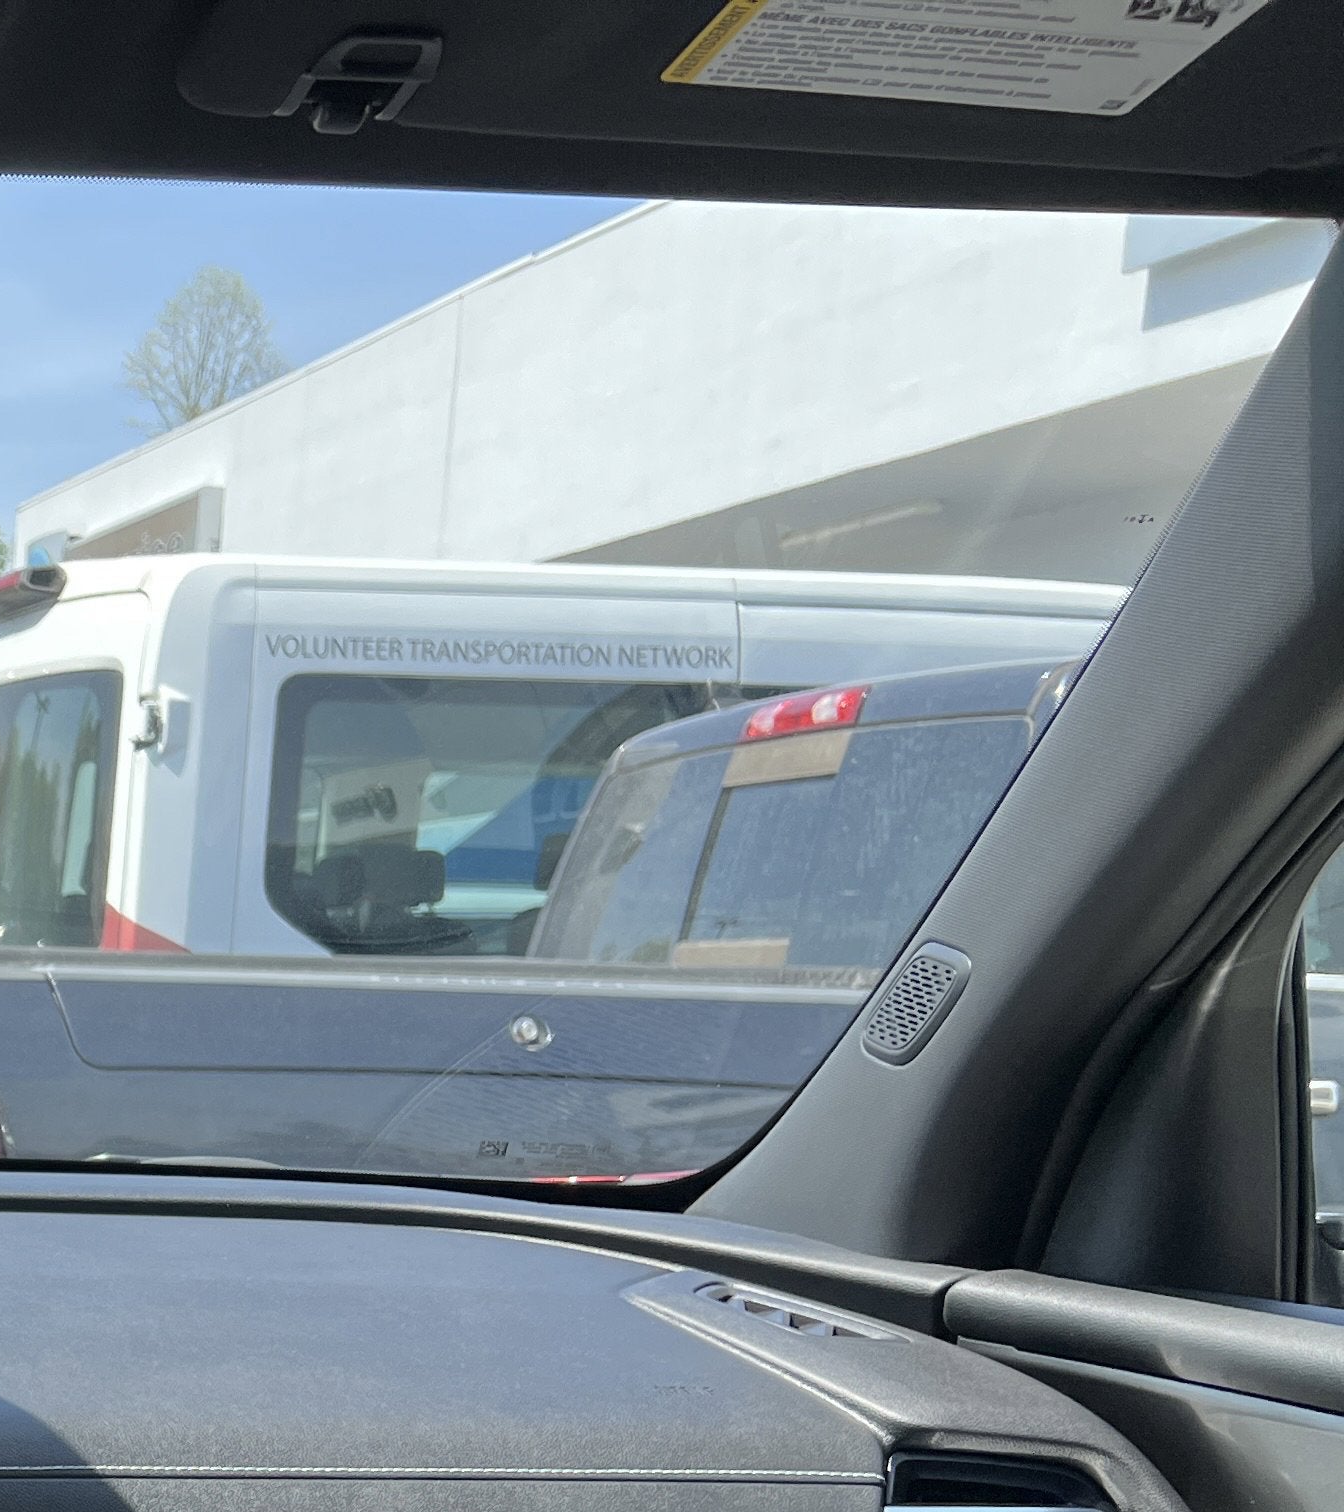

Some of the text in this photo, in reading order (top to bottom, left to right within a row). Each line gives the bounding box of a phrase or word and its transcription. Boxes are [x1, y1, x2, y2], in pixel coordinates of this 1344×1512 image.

[808, 15, 848, 27] AVEC
[852, 18, 881, 29] DES
[884, 20, 928, 33] SACS
[265, 634, 733, 670] VOLUNTEER TRANSPORTATION NETWORK
